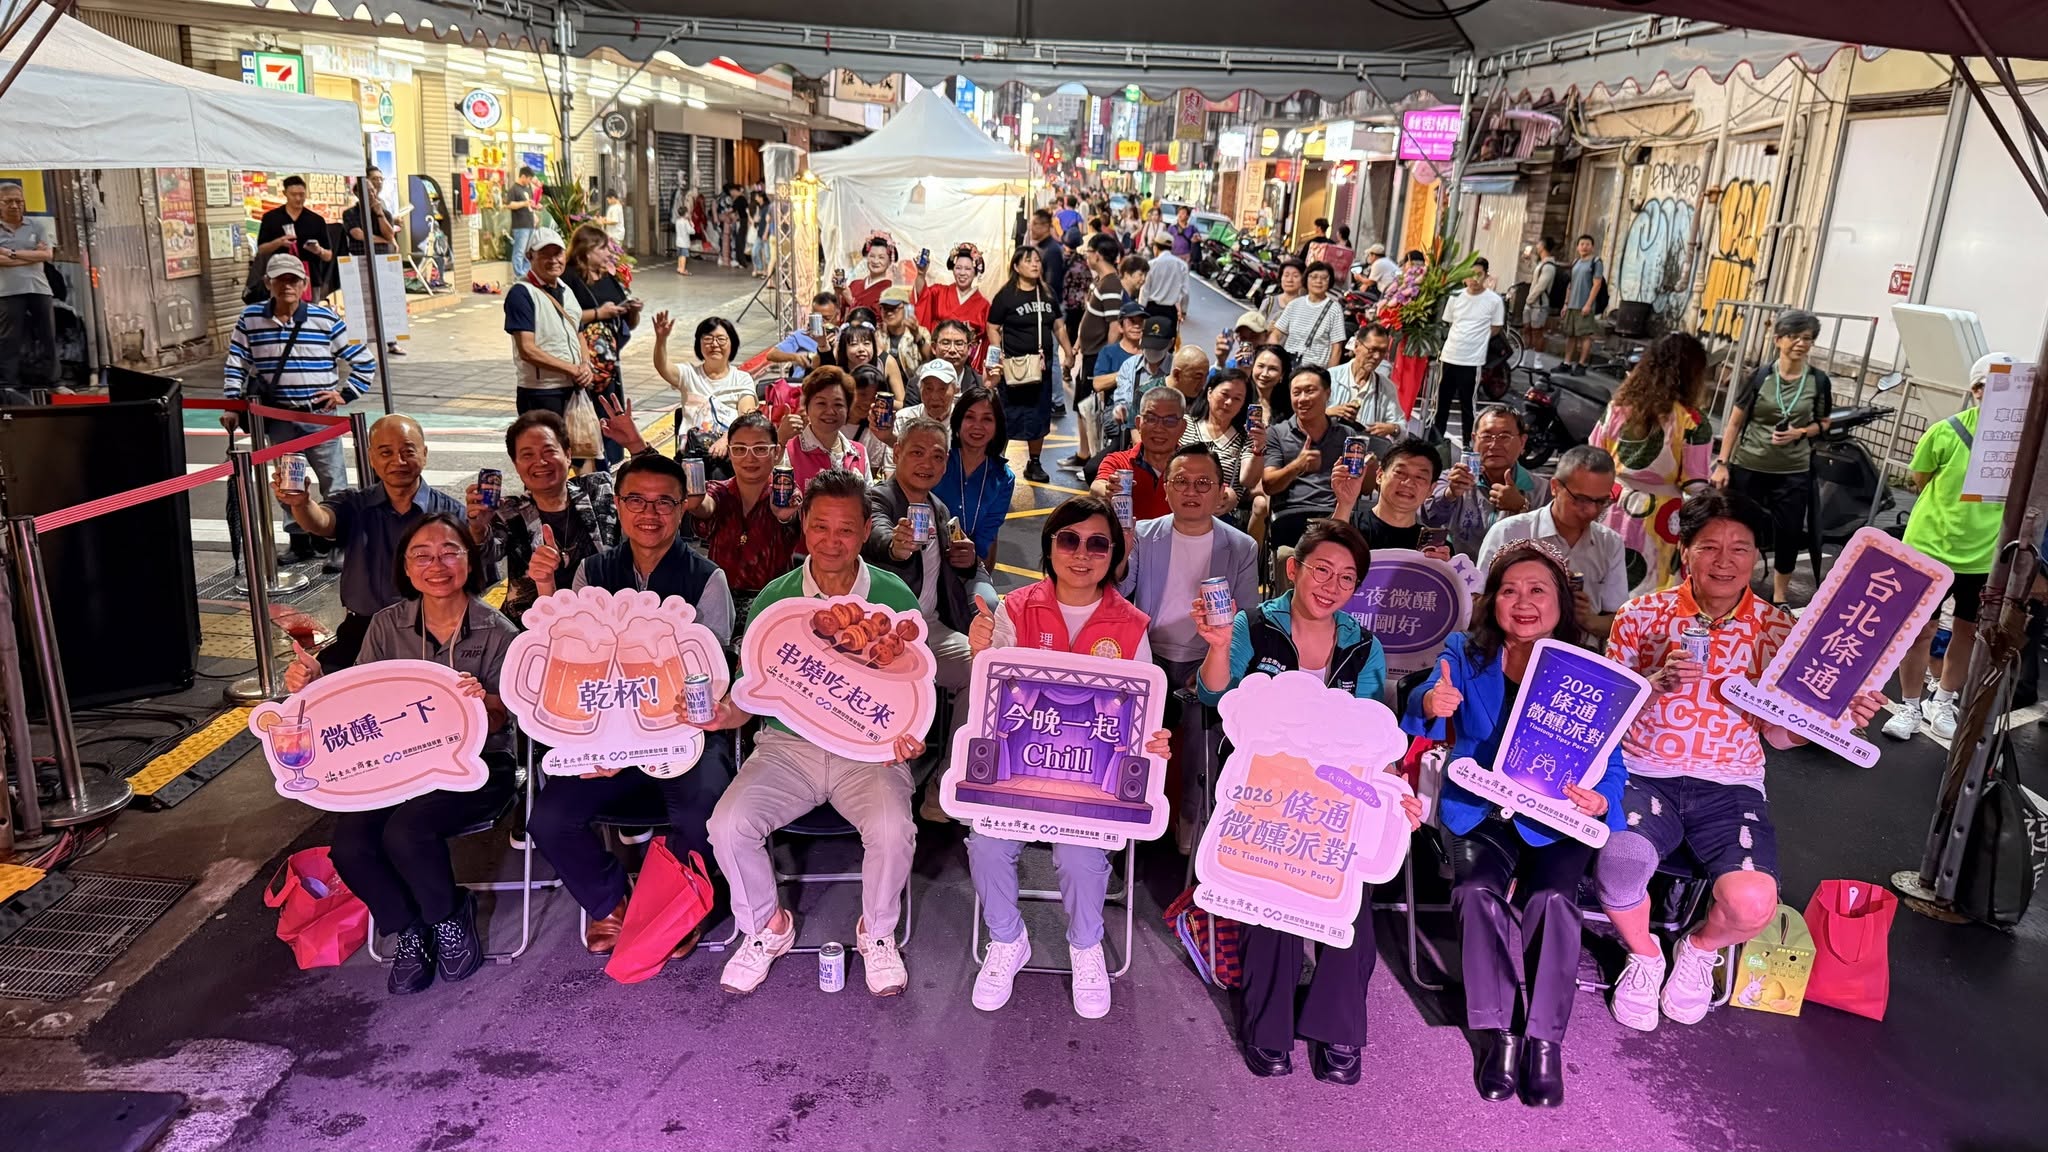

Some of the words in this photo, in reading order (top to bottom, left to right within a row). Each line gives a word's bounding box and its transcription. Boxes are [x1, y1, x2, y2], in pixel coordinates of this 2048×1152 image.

[1040, 632, 1053, 650] 理
[1796, 567, 1902, 700] 台北條通
[579, 678, 658, 711] 乾杯!
[776, 642, 895, 729] 串燒吃起來
[1559, 675, 1605, 703] 2026
[320, 696, 435, 753] 微醺一下
[1002, 703, 1120, 743] 今晚一起
[1526, 701, 1605, 747] 微醺派對
[1551, 690, 1598, 723] 條通
[1022, 743, 1093, 773] Chill
[1555, 733, 1571, 747] Tipsy
[1572, 740, 1589, 753] Party
[1232, 785, 1273, 803] 2026
[1282, 788, 1352, 834] 條通
[1218, 808, 1359, 872] 微醺派對
[1217, 844, 1237, 856] 2026
[1241, 850, 1279, 869] Tiaotong
[1283, 862, 1307, 877] Tipsy
[1311, 870, 1336, 885] Party
